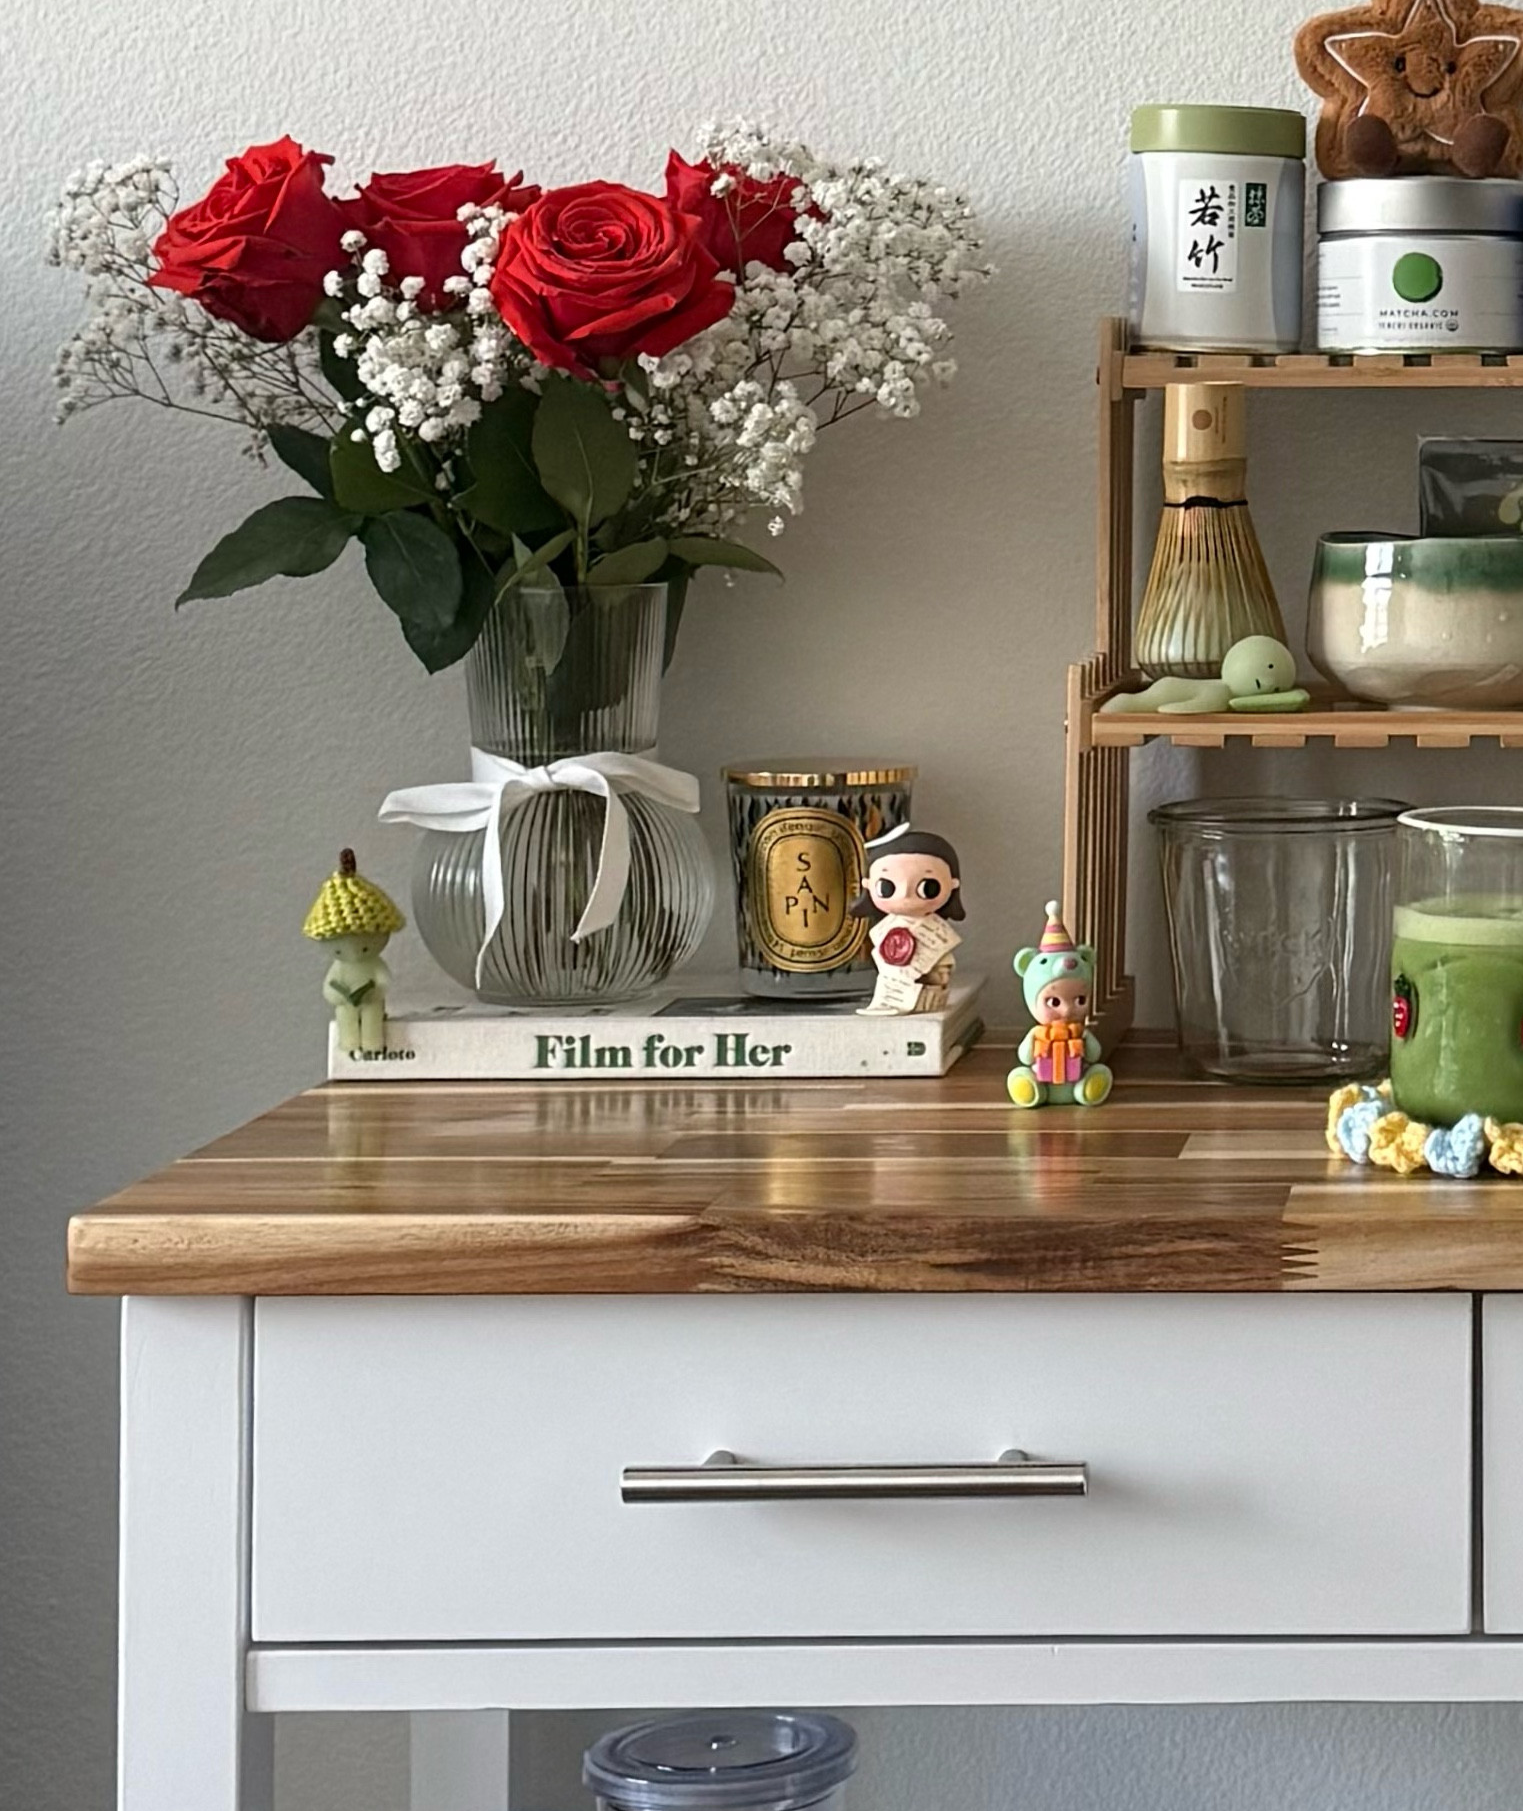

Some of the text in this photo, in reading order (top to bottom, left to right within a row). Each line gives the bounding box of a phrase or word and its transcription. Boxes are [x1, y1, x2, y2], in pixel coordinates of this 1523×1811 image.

[1188, 185, 1225, 274] 若竹
[1379, 309, 1459, 318] MATCHA.COM
[533, 1032, 792, 1069] Film for Her
